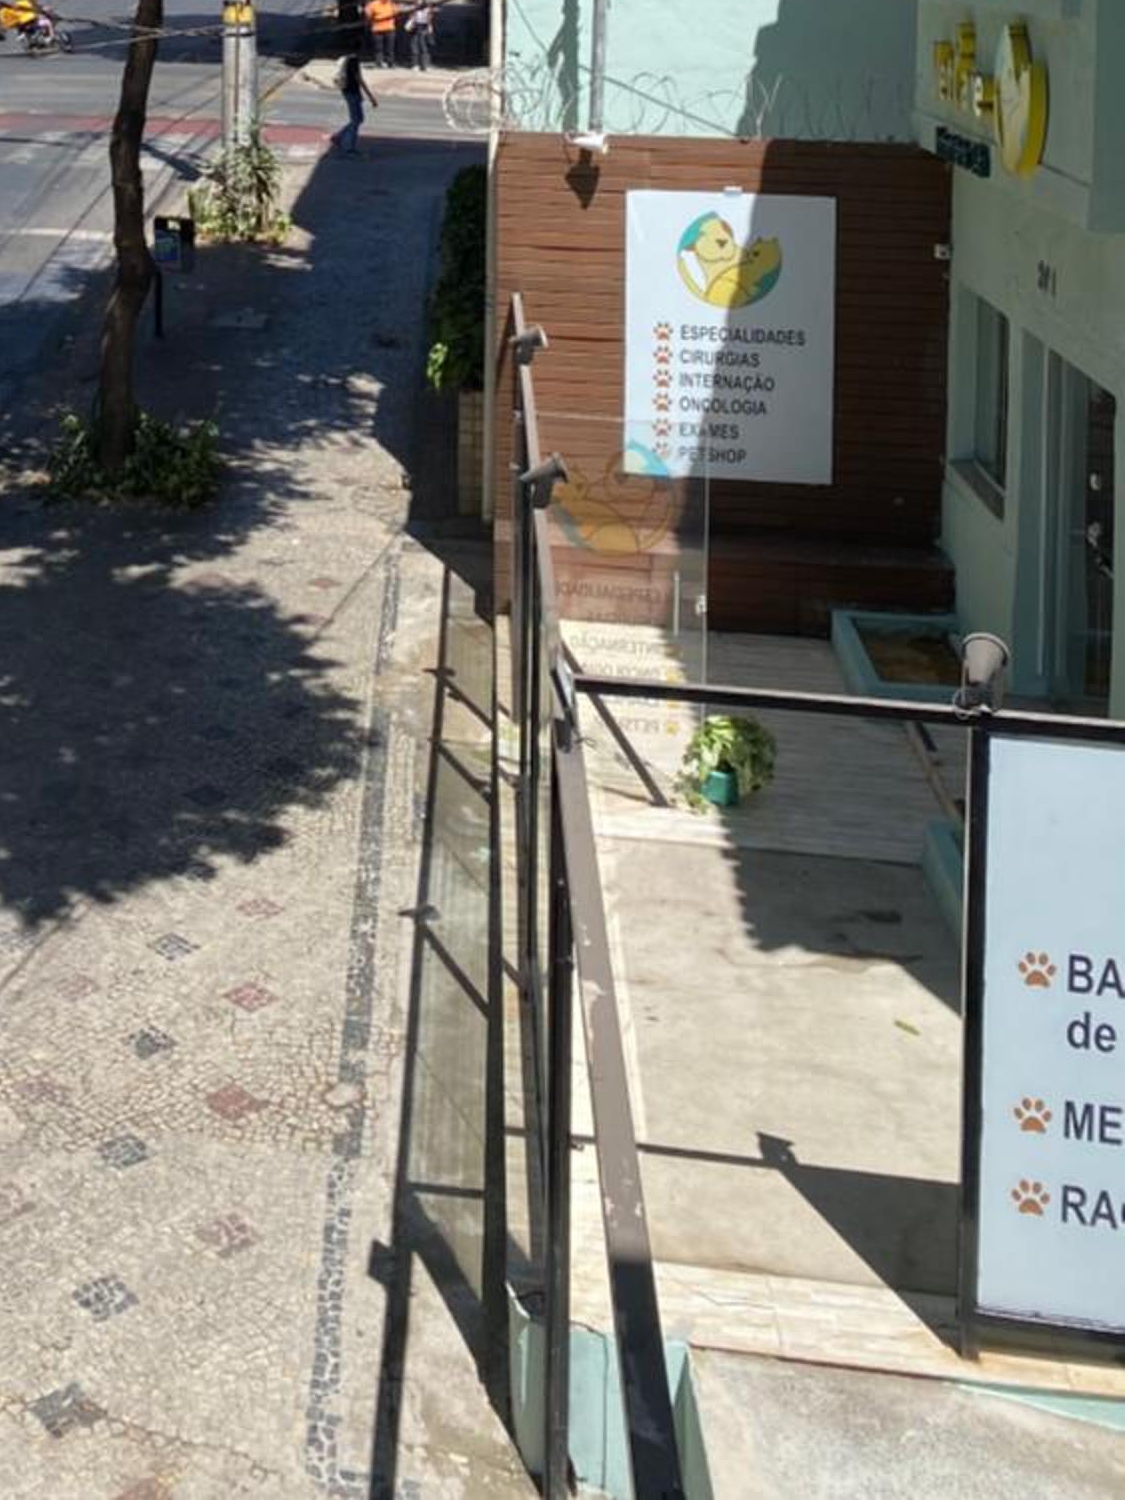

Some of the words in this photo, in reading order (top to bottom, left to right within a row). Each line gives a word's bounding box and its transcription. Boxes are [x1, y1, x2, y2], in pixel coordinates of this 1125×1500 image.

[680, 324, 806, 346] ESPECIALIDADES
[679, 349, 760, 368] CIRURGIAS
[678, 373, 775, 393] INTERNAÇÃO
[679, 396, 767, 415] ONCOLOGIA
[679, 422, 740, 439] EXAMES
[1066, 1011, 1117, 1053] de
[1064, 1100, 1123, 1146] ME
[1062, 1184, 1125, 1230] RA
